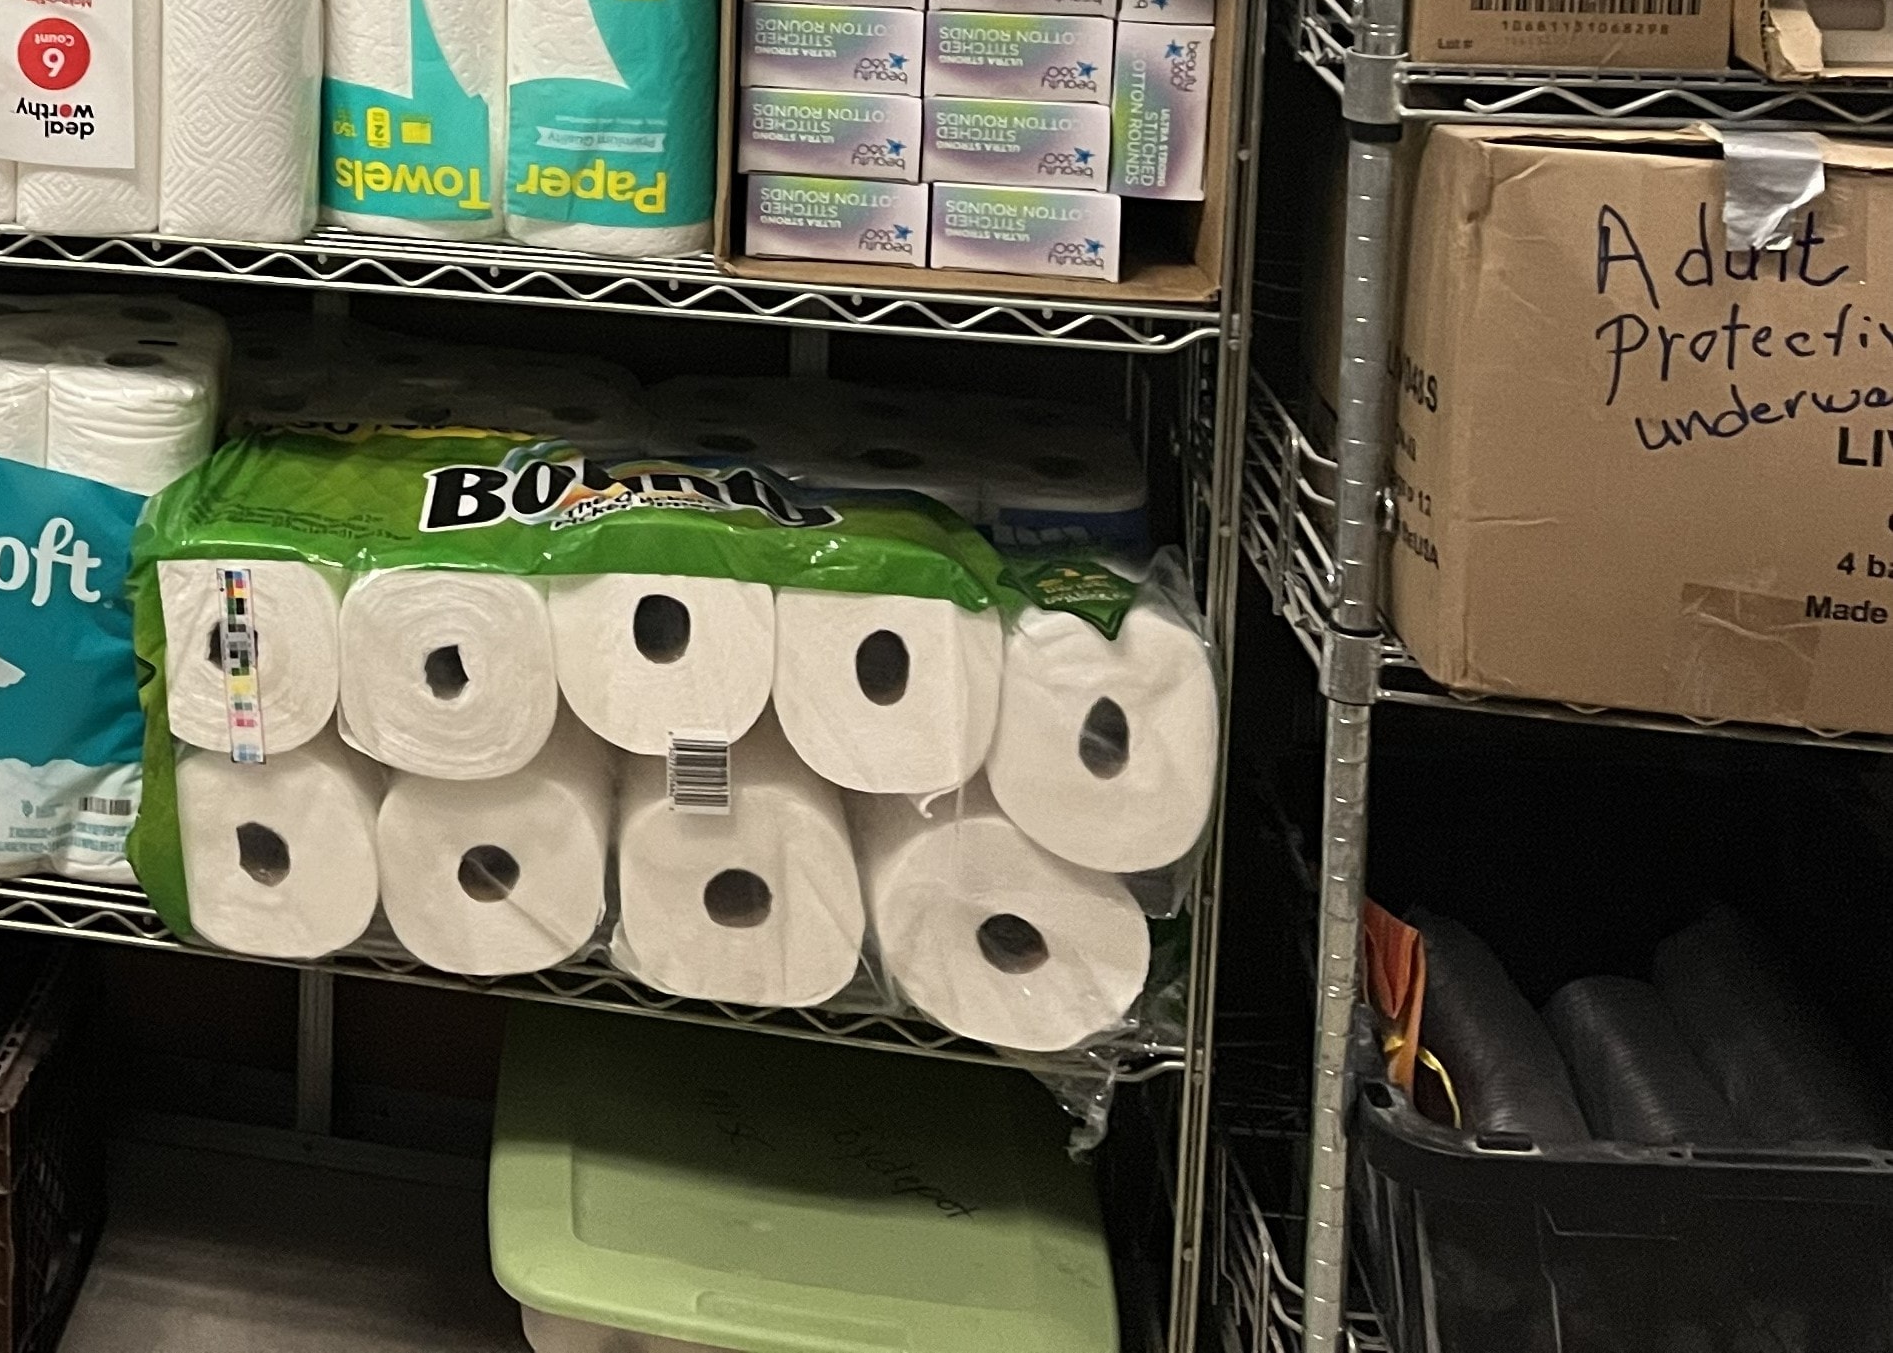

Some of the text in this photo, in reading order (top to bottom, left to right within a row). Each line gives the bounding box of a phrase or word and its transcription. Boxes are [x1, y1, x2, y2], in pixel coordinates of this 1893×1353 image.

[34, 33, 75, 47] Count
[42, 47, 66, 78] 6
[16, 97, 94, 121] worthy
[44, 119, 95, 140] deal
[335, 157, 492, 211] Towels
[516, 160, 667, 214] Paper
[1837, 552, 1856, 576] 4
[1806, 595, 1888, 625] Made
